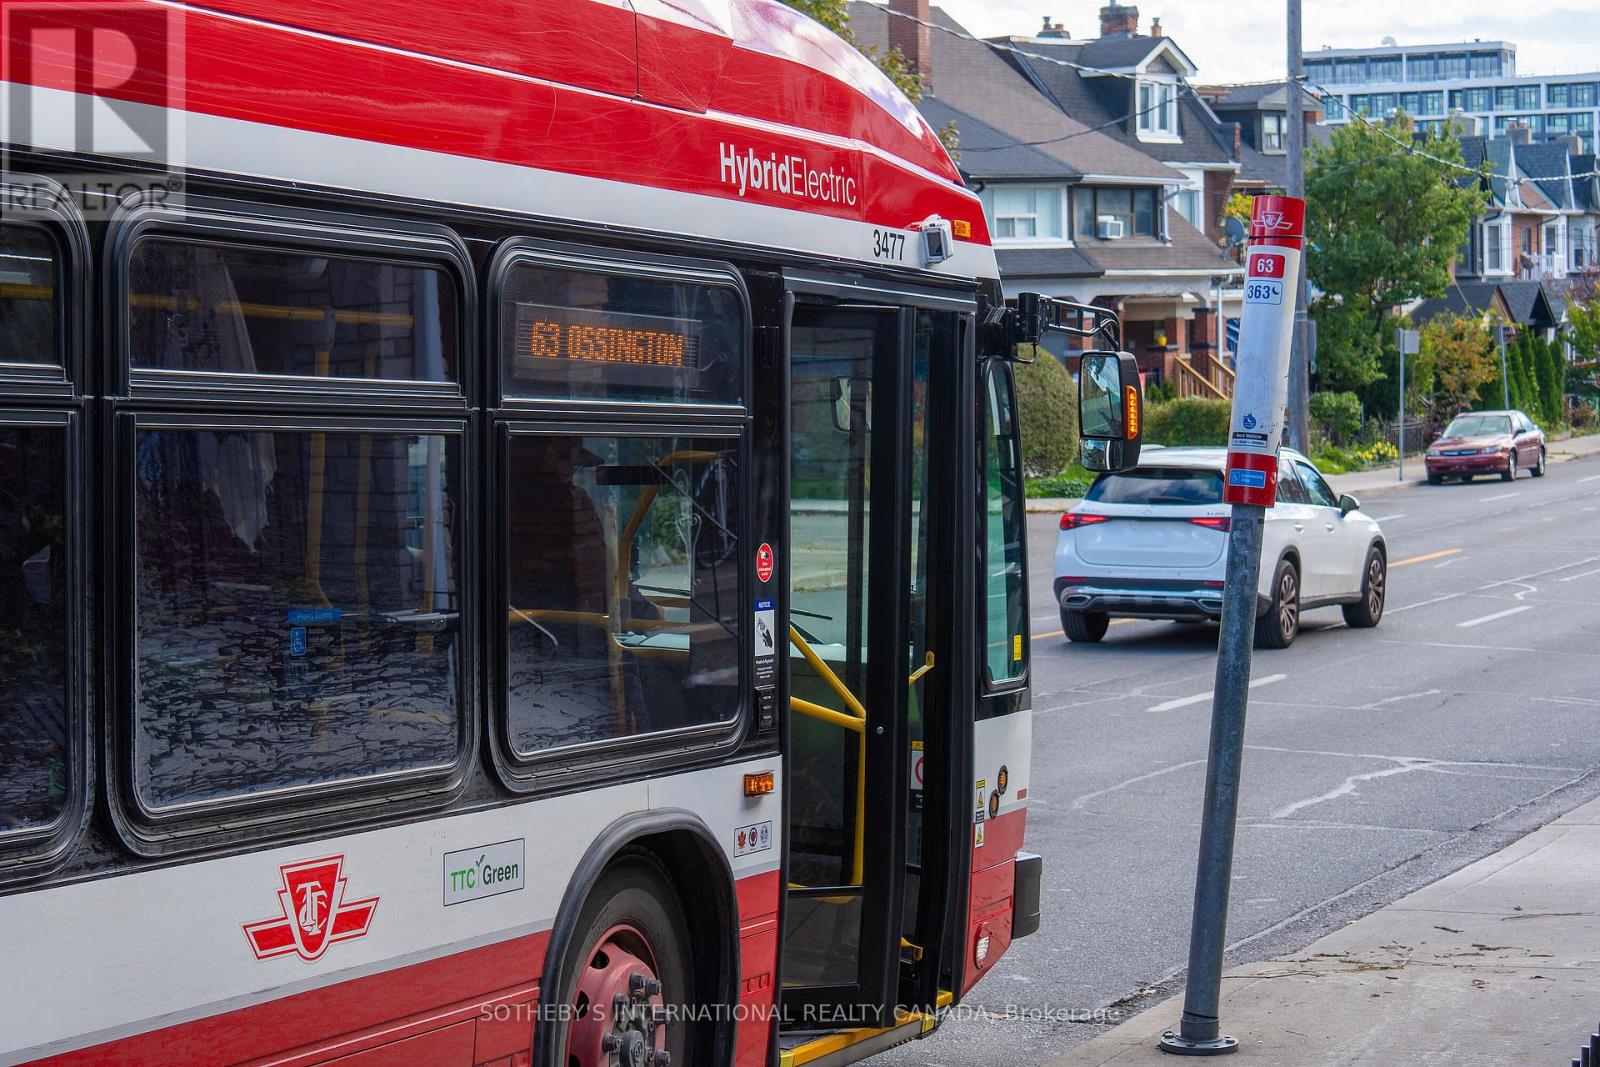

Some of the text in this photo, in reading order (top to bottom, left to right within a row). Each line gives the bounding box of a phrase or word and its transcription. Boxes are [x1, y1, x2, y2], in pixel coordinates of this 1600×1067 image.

[719, 142, 857, 206] HybridElectric
[873, 229, 905, 261] 3477
[1257, 258, 1274, 273] 63
[1247, 285, 1270, 299] 363
[531, 321, 685, 367] 63 OSSINGTON
[450, 862, 519, 892] TTC Green
